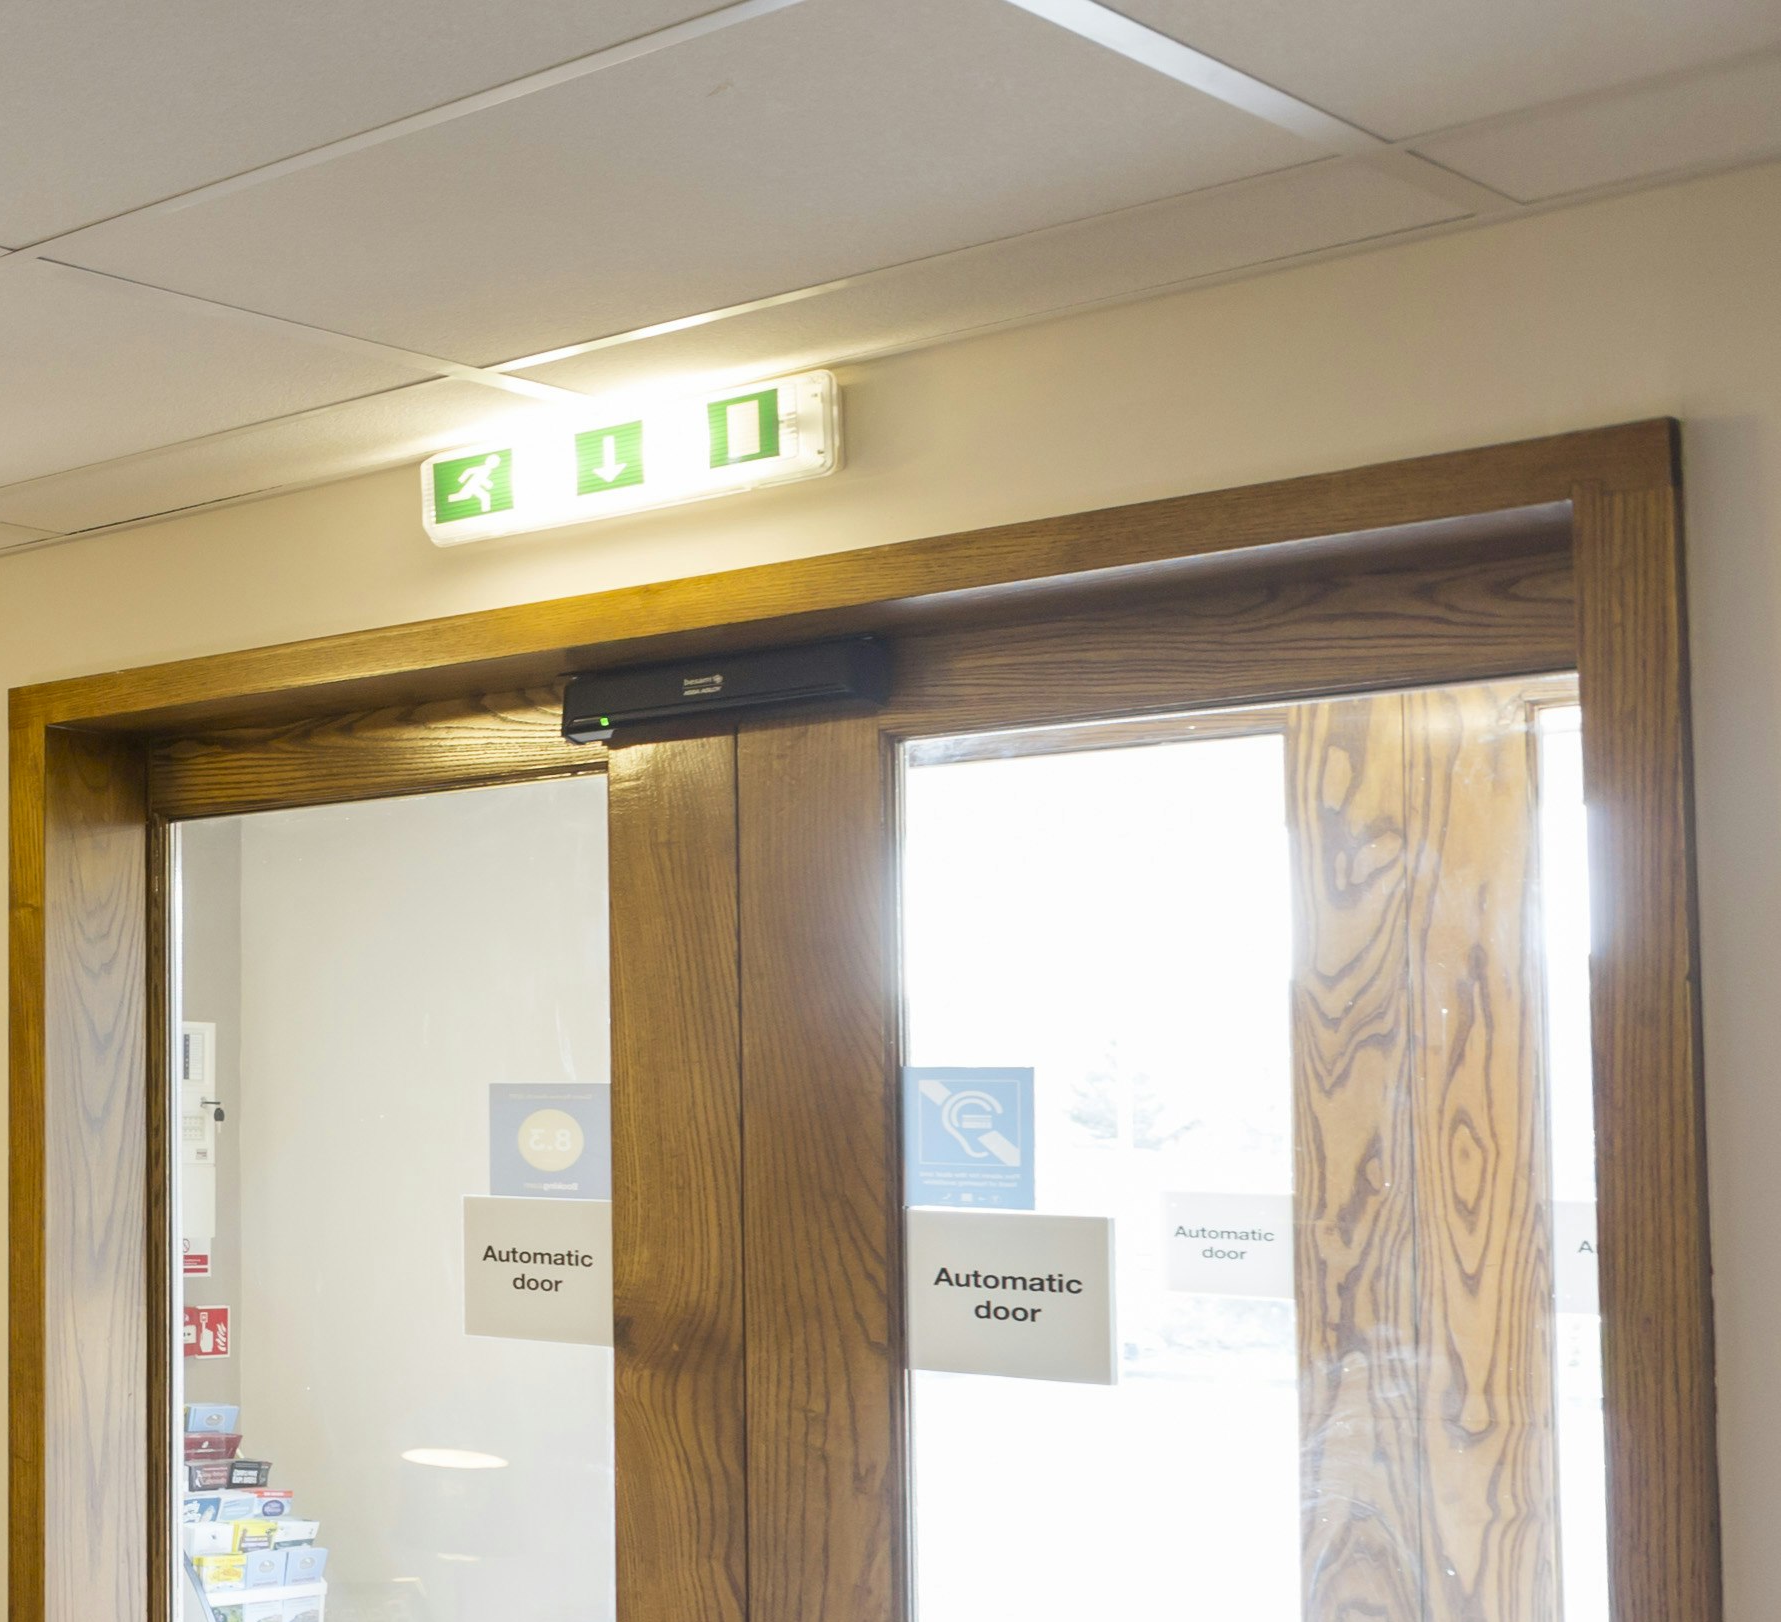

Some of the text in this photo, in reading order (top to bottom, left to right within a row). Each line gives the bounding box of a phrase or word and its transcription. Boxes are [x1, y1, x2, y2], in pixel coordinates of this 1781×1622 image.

[1174, 1225, 1275, 1242] Automatic
[482, 1245, 594, 1268] Automatic
[1202, 1247, 1247, 1260] door
[512, 1273, 563, 1292] door
[934, 1267, 1083, 1295] Automatic
[974, 1300, 1042, 1322] door
